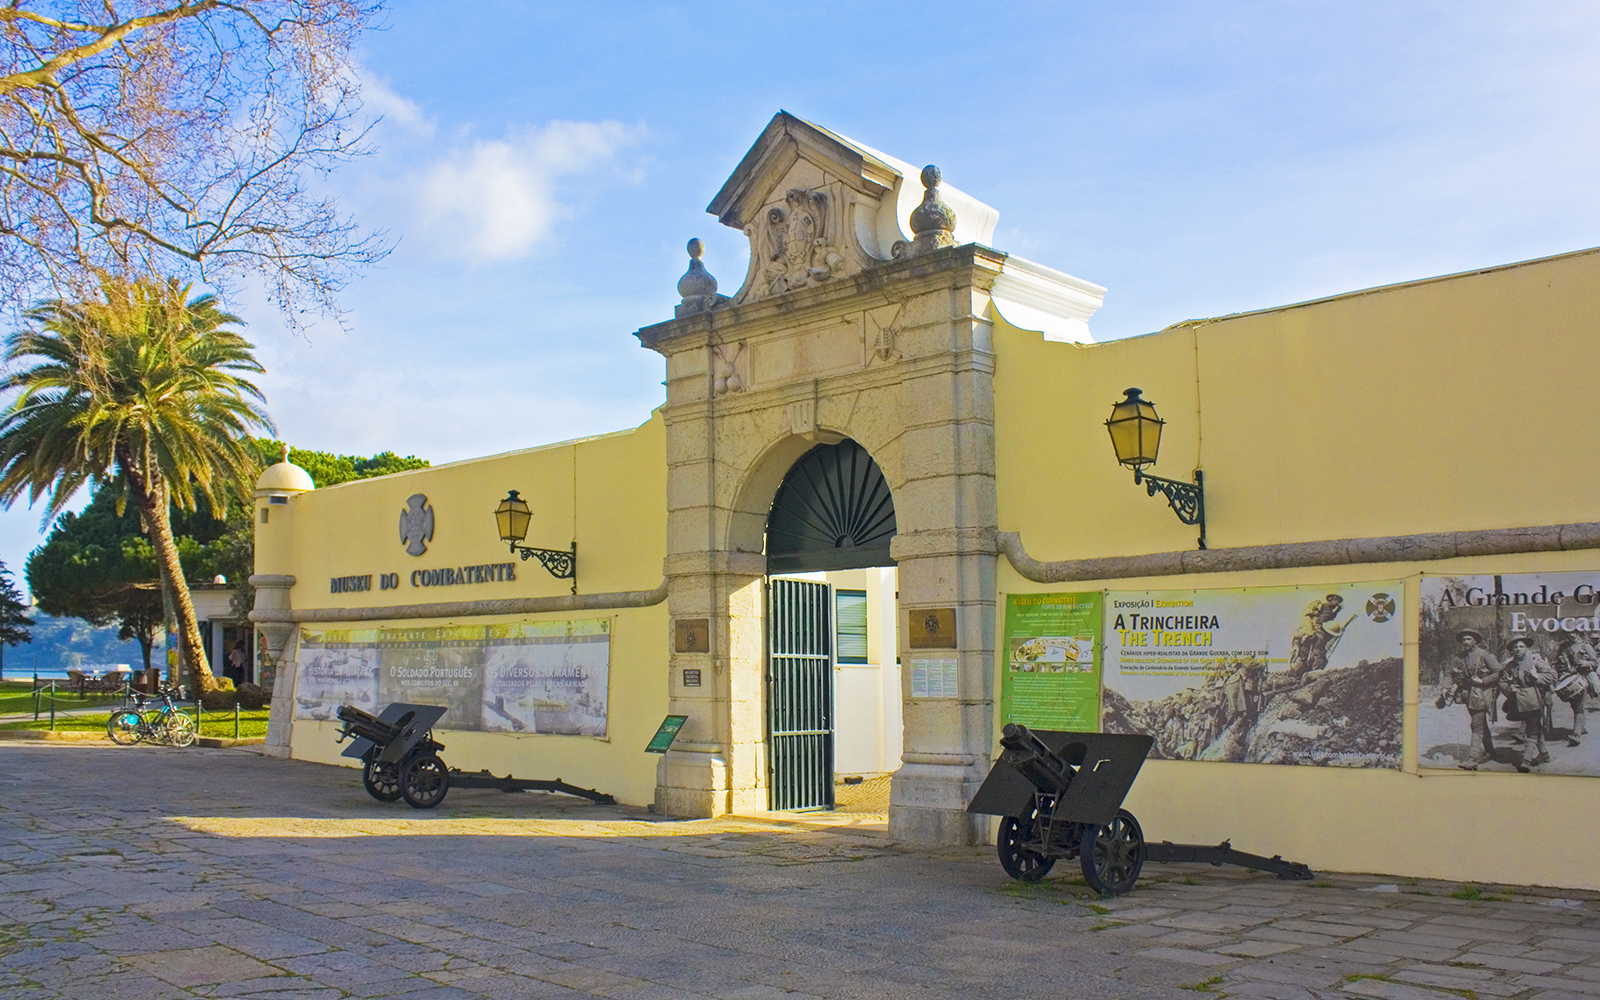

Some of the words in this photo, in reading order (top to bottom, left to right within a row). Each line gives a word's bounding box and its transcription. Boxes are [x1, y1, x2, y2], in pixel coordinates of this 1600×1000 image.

[330, 574, 372, 593] MUSEU
[379, 572, 399, 590] DO
[410, 562, 516, 587] COMBATENTE
[1013, 598, 1032, 606] MUSEU
[1033, 598, 1041, 606] DO
[1042, 596, 1077, 605] COMBATENTE
[1439, 587, 1457, 607] A
[1465, 584, 1565, 607] Grande
[1114, 600, 1149, 609] EXPOSIÇÃO
[1155, 599, 1193, 608] EXHIBITION
[1113, 613, 1126, 630] A
[1129, 613, 1220, 630] TRINCHEIRA
[436, 627, 500, 640] EXPOSIÇÕES
[1118, 629, 1148, 646] THE
[1152, 629, 1212, 646] TRENCH
[390, 666, 396, 677] O
[397, 666, 429, 678] SOLDADO
[430, 665, 472, 678] PORTUGUÊS
[500, 666, 540, 678] DIVERSOS
[495, 680, 525, 688] UTILIZADOS
[525, 680, 543, 688] PELAS
[565, 680, 592, 688] ARMADAS
